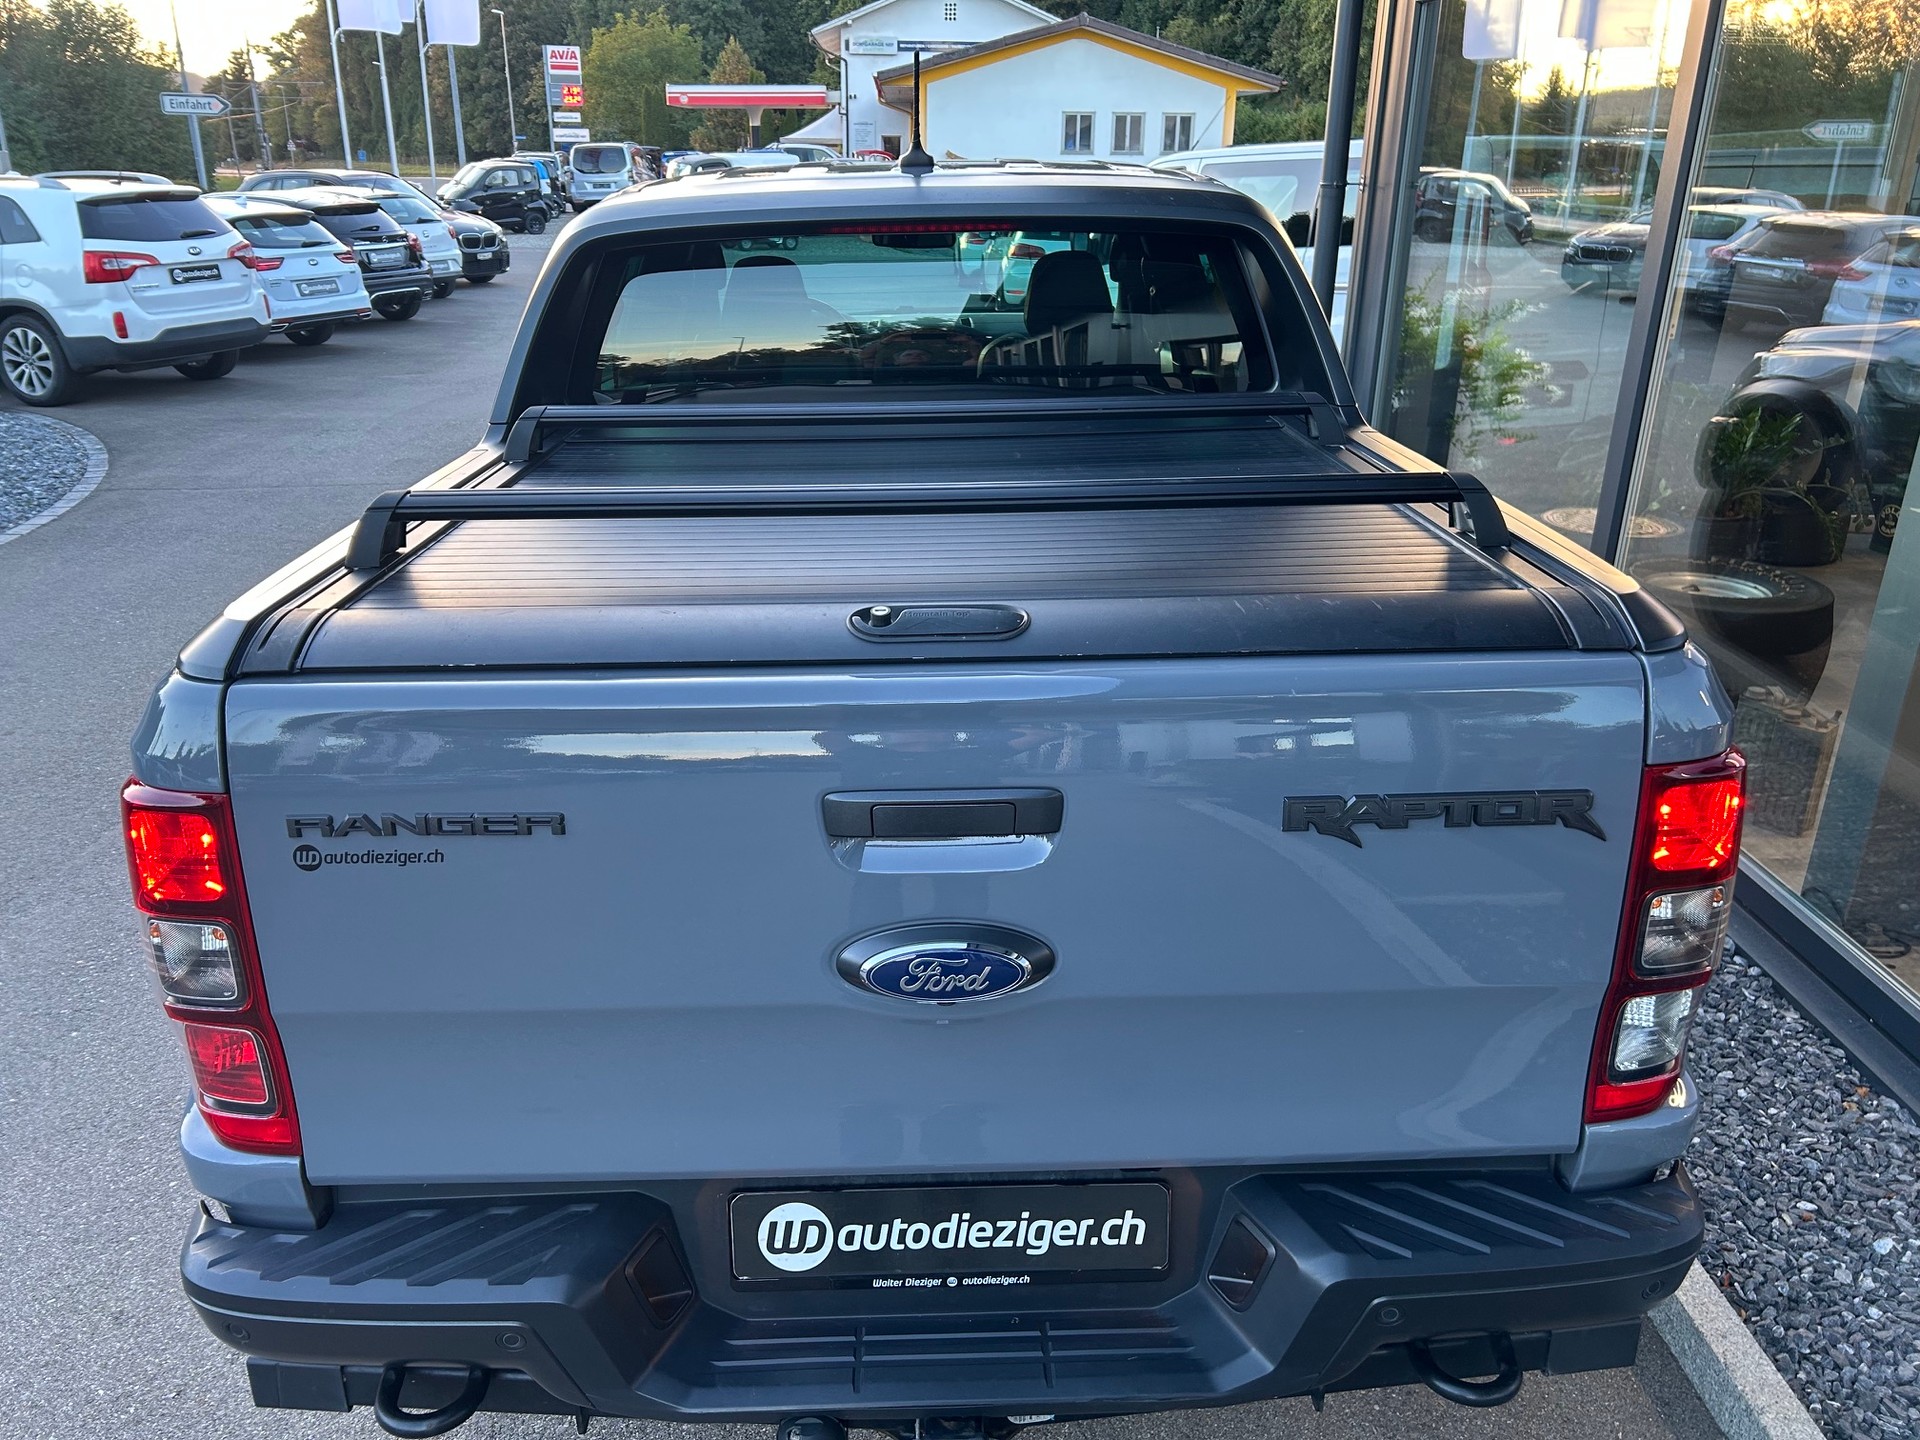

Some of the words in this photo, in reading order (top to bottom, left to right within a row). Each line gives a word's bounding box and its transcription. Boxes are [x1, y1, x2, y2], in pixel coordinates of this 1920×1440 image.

[169, 98, 213, 111] Einfahrt
[286, 813, 566, 838] RANGER
[1282, 789, 1606, 848] RAPTOR
[324, 849, 444, 866] autodieziger.ch
[900, 957, 991, 992] Ford
[837, 1209, 1147, 1256] autodieziger.ch
[872, 1278, 903, 1288] Walter
[905, 1277, 942, 1288] Dieziger
[962, 1275, 1030, 1286] autodieziger.ch
